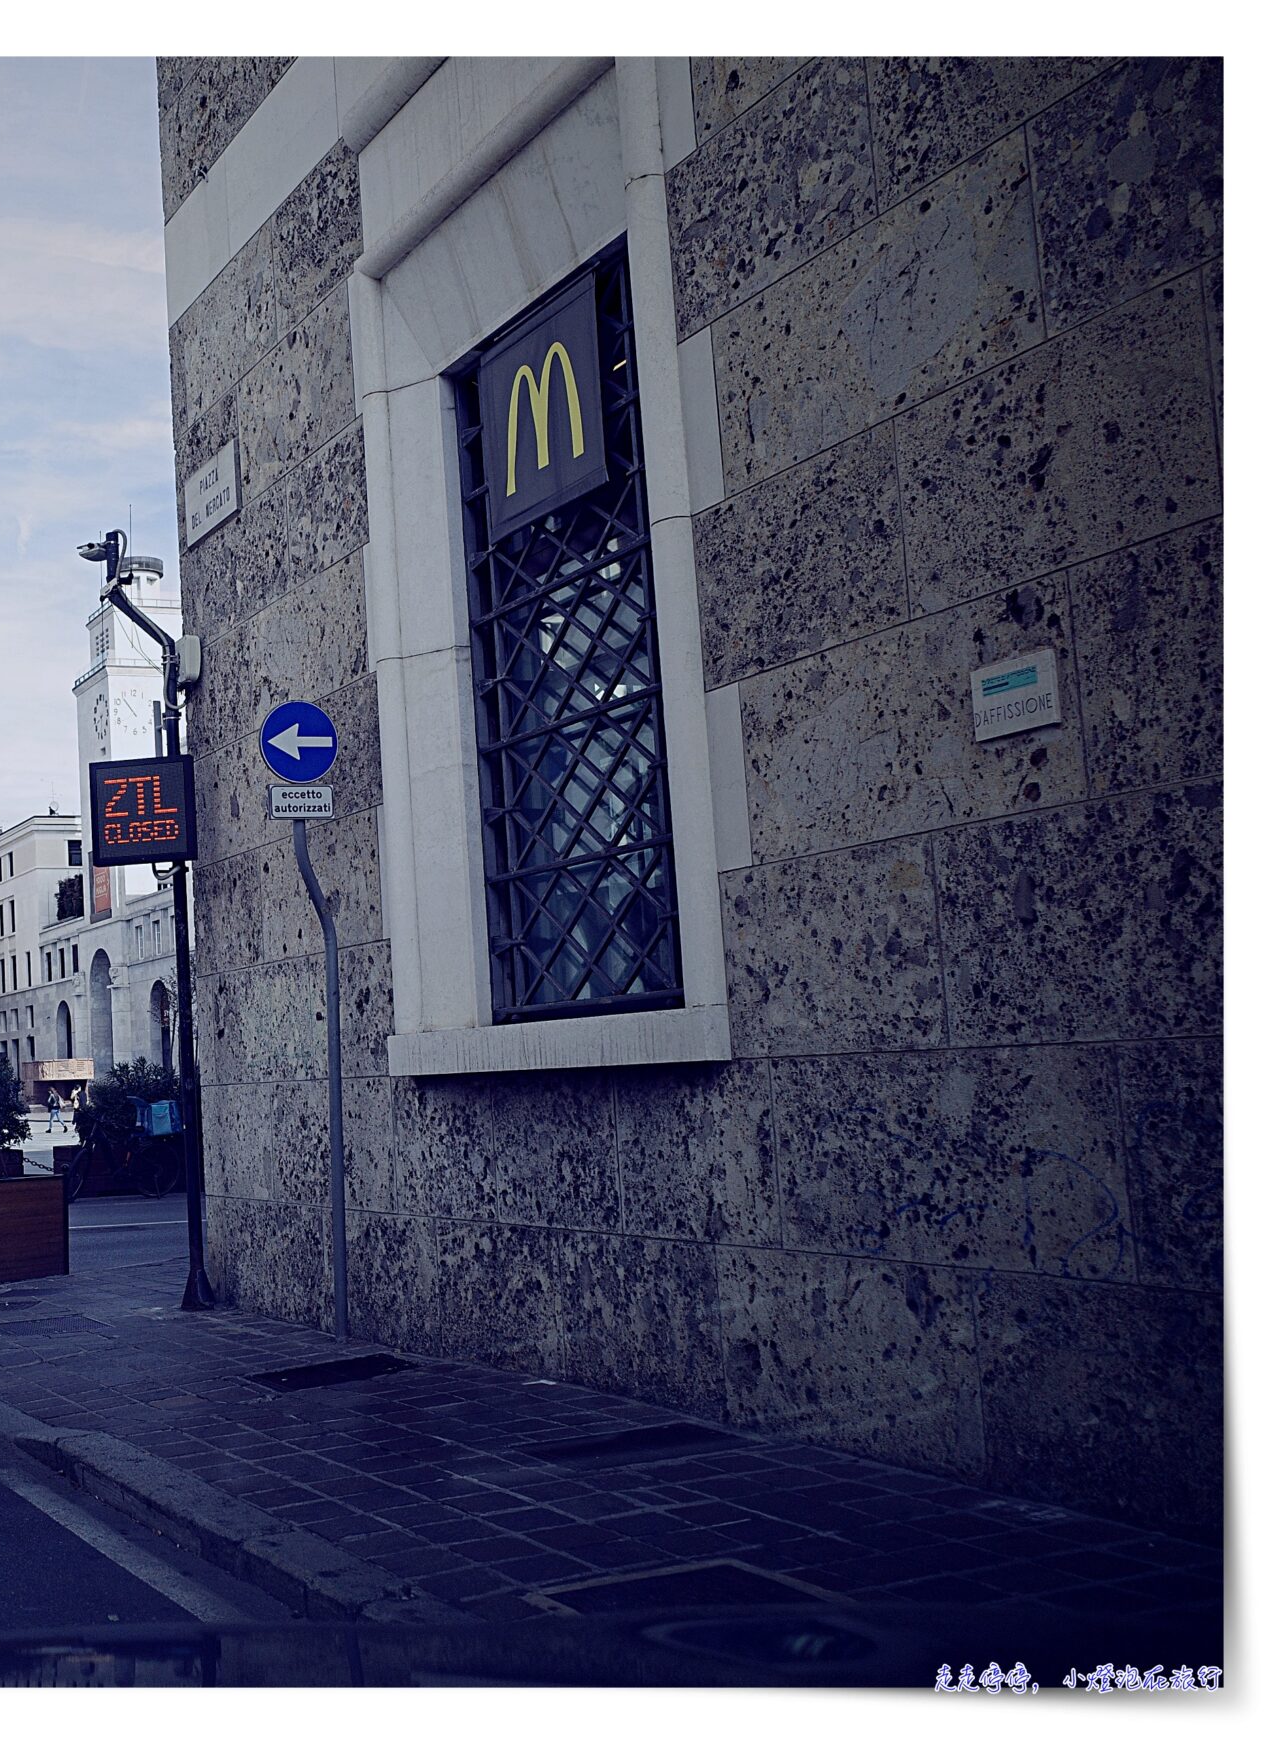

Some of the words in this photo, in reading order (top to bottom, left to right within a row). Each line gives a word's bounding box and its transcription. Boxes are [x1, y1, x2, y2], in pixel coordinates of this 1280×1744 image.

[200, 467, 218, 496] PIAZZA
[192, 512, 202, 530] DEL
[206, 486, 230, 518] MERCATO
[131, 689, 137, 697] 12
[103, 775, 178, 818] ZTL
[281, 789, 323, 799] eccetto
[274, 802, 331, 813] autorizzati
[104, 819, 179, 844] CLOSED
